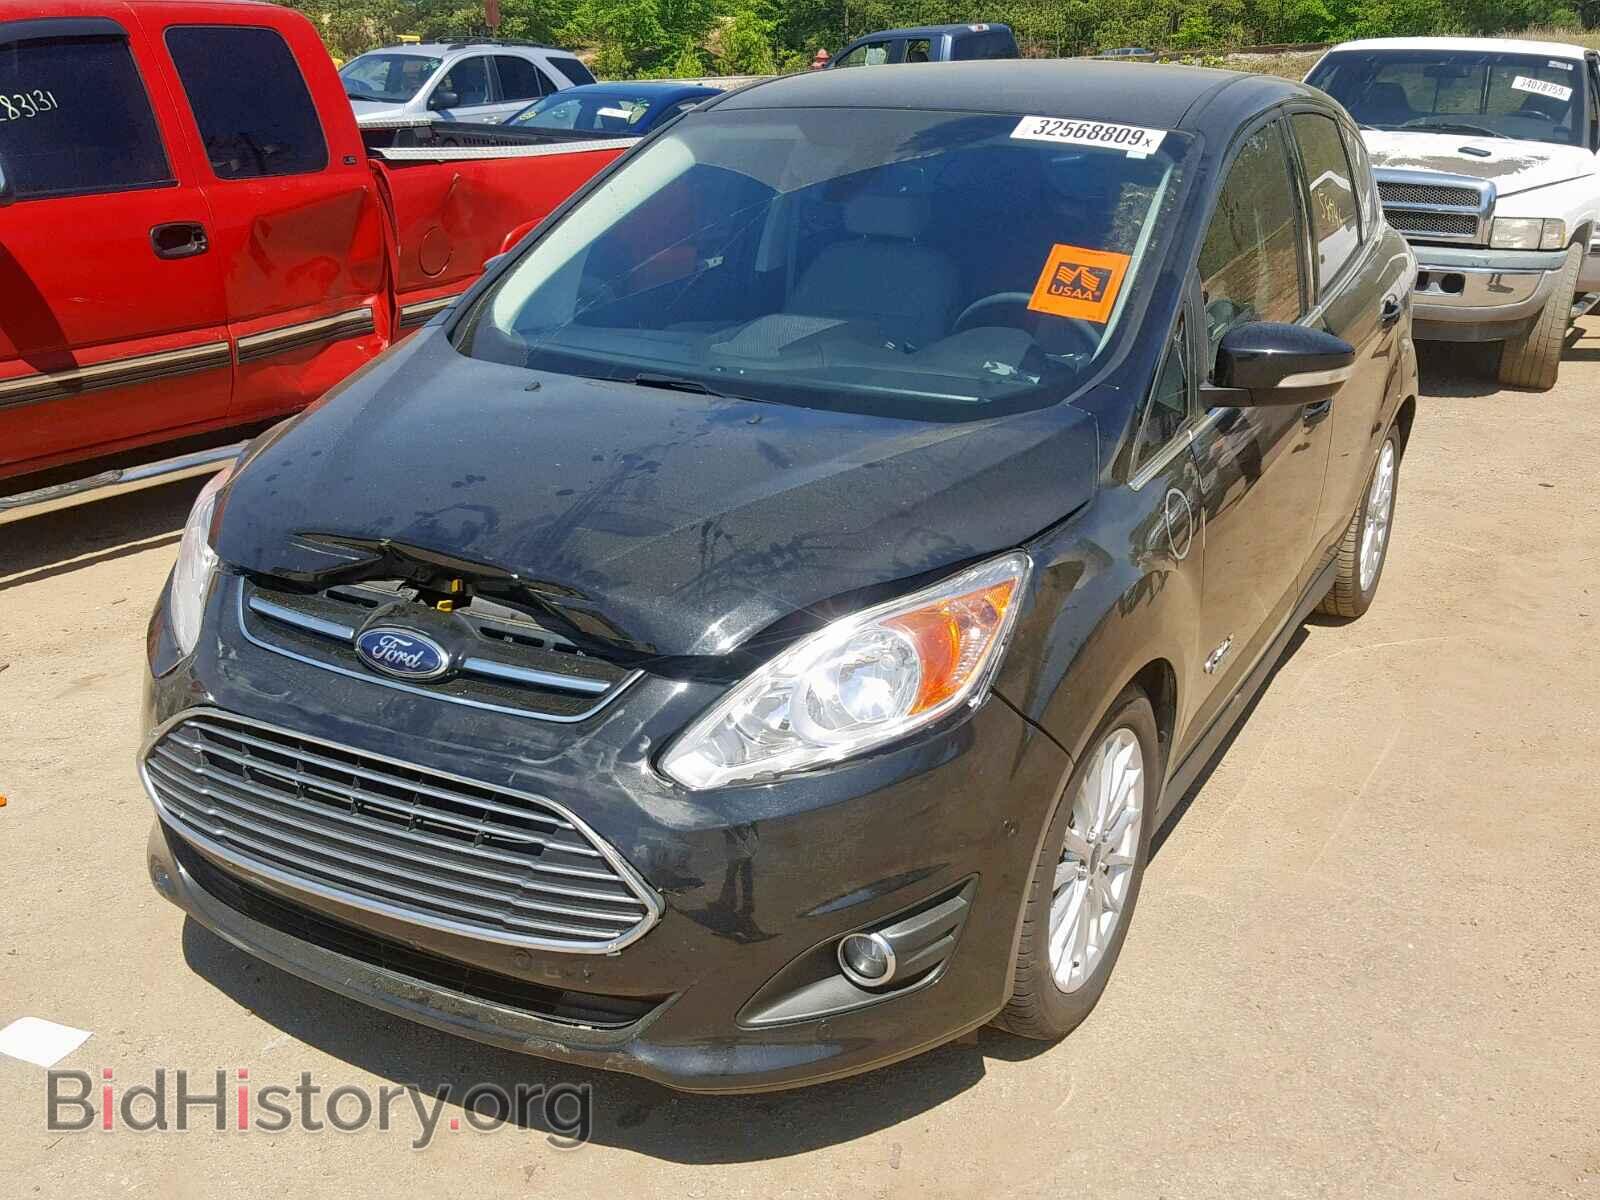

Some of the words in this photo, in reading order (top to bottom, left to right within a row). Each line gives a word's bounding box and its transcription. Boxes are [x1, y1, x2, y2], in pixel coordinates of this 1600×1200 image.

[0, 89, 58, 121] 83131
[1050, 284, 1094, 301] USAA
[372, 635, 425, 669] Ford
